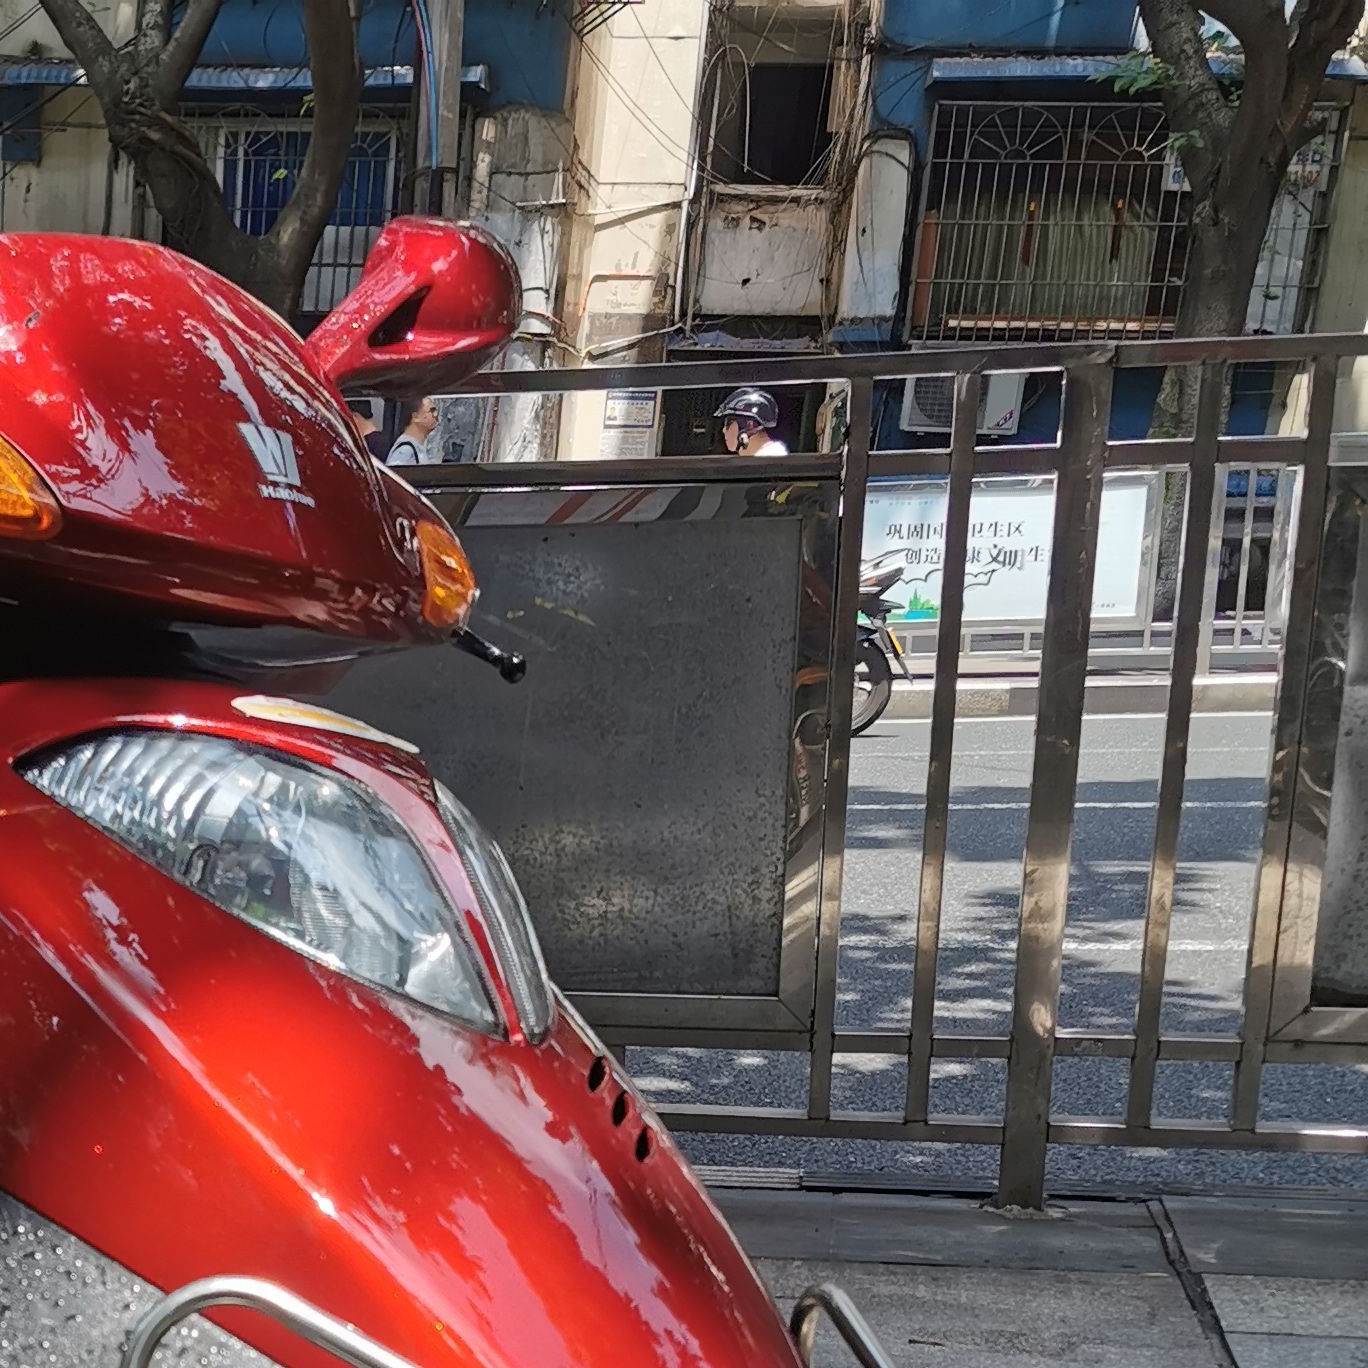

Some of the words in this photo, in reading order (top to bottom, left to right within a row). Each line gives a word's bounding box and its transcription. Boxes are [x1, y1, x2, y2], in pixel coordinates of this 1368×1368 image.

[886, 522, 1025, 540] 巩固国卫生区
